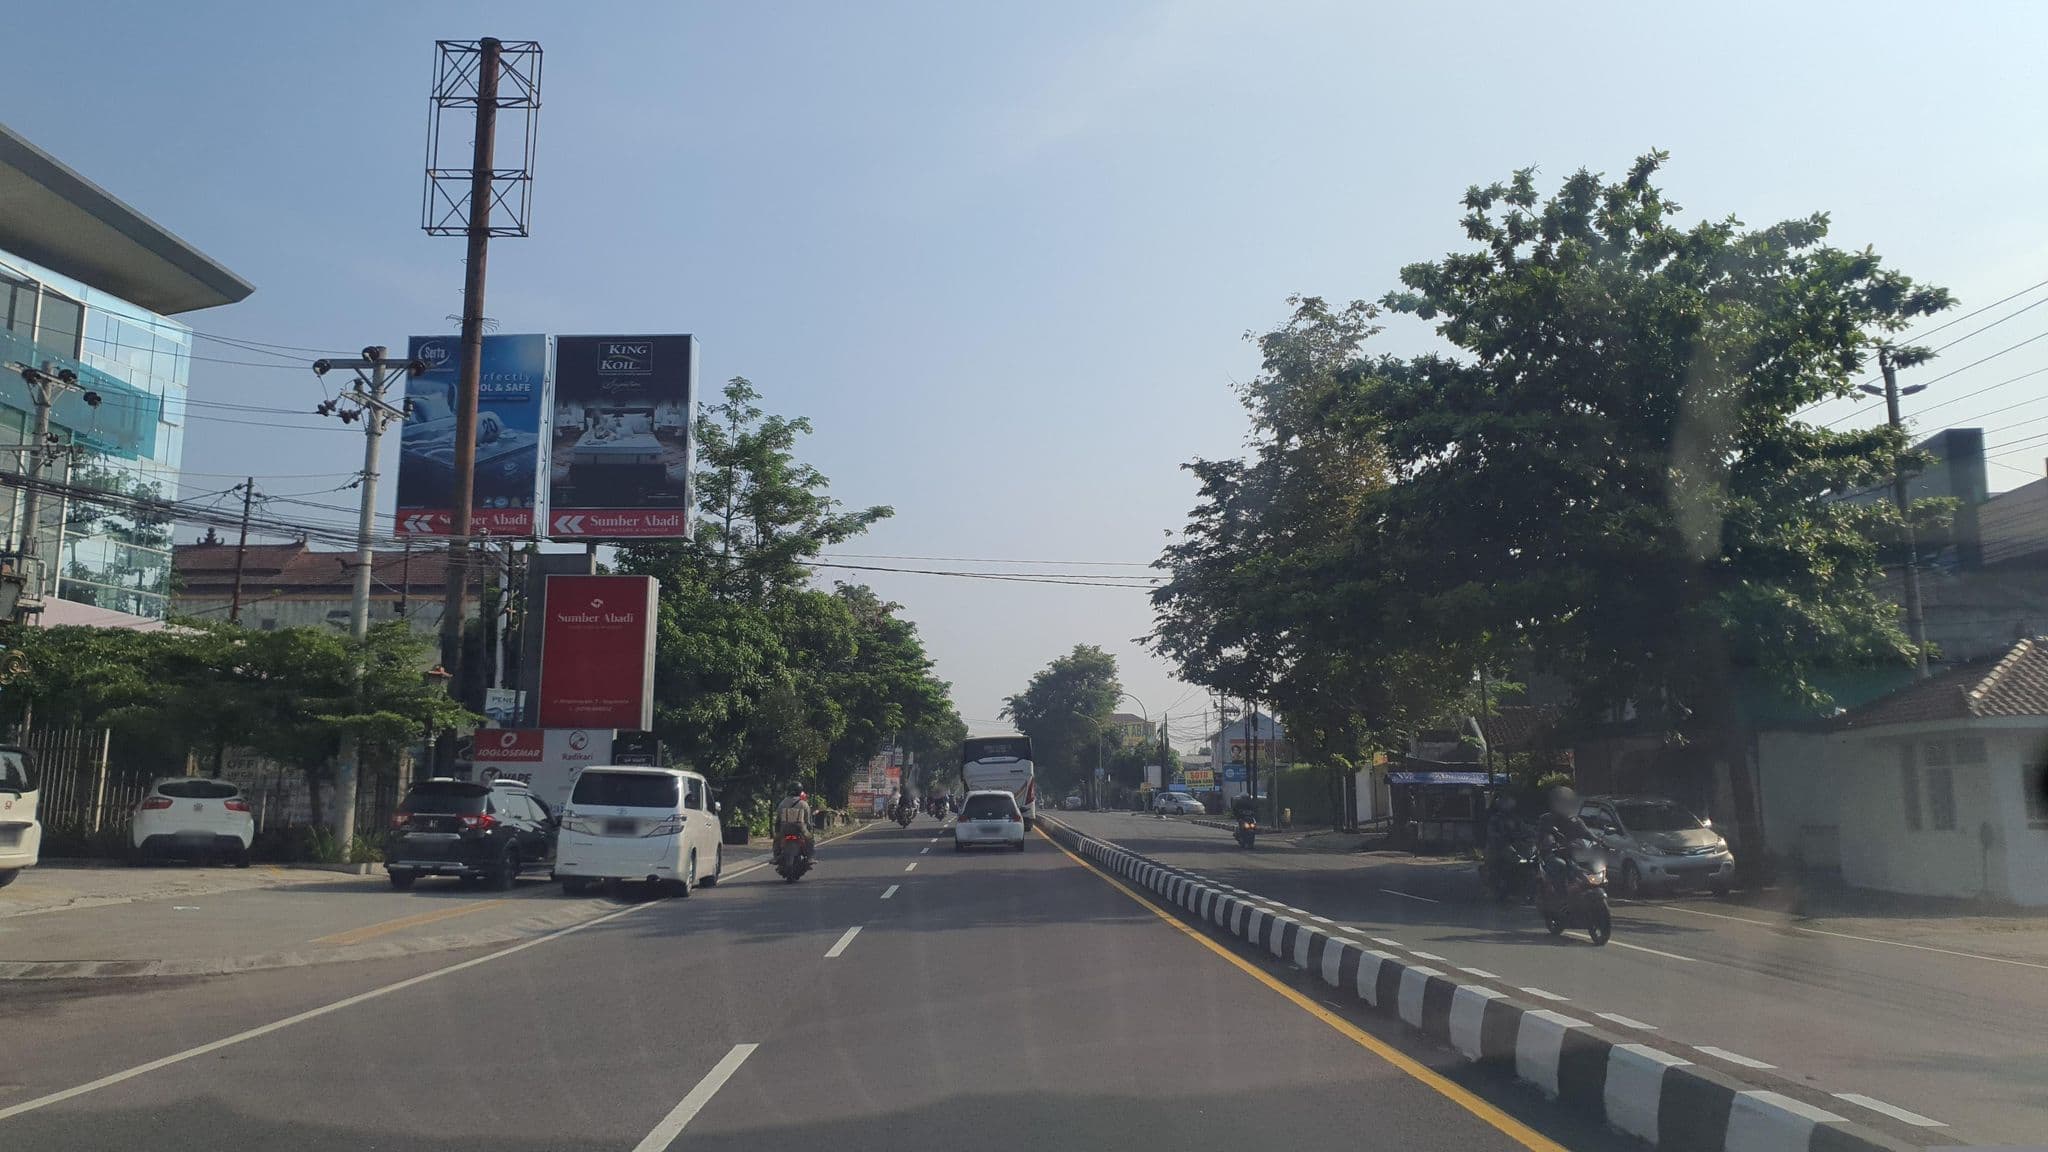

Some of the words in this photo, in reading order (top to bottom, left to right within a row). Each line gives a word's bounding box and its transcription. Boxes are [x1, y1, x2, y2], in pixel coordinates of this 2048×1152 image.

[424, 346, 446, 359] Serta
[609, 344, 648, 354] KING
[600, 360, 641, 370] KOIL
[495, 383, 503, 392] &
[505, 383, 531, 392] SAFE
[494, 513, 527, 525] Abadi
[590, 515, 640, 526] Sumber
[645, 514, 679, 527] Abadi
[557, 612, 600, 623] Sumber
[605, 612, 634, 623] Abadi
[478, 748, 541, 758] JOGLOSEMAR
[561, 752, 593, 761] Radikari
